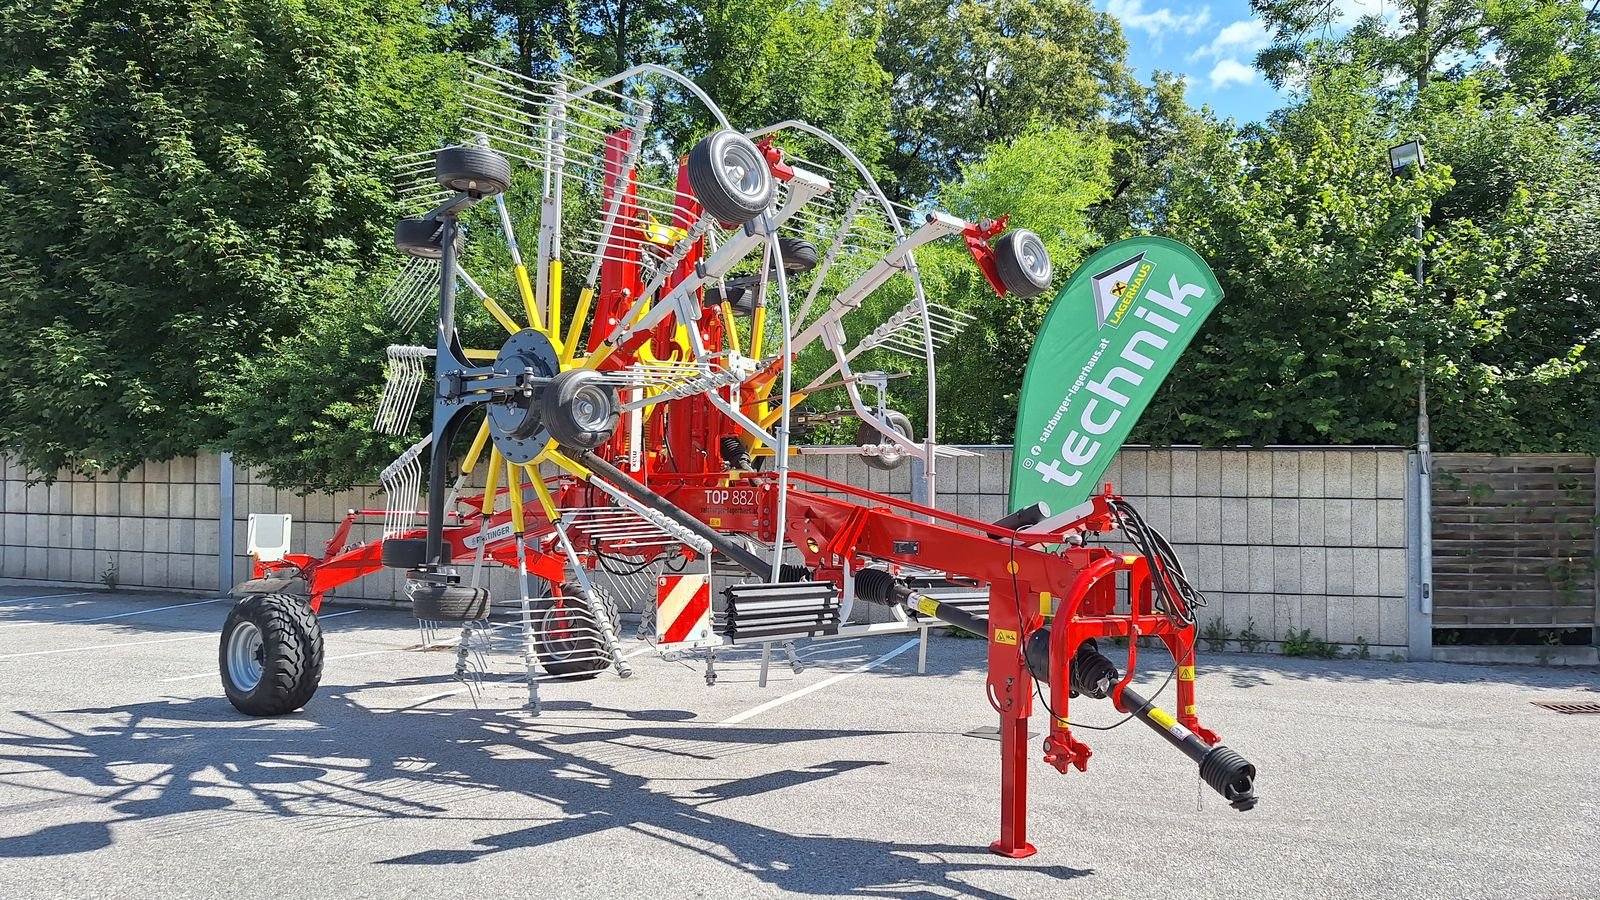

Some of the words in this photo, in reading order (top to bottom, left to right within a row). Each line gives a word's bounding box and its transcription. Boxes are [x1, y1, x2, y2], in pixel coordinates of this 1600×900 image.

[1110, 263, 1152, 325] LAGERHAUS
[1034, 273, 1206, 488] technik
[1039, 337, 1110, 443] salzburger-lagerhaus.at
[704, 489, 729, 505] TOP
[476, 525, 511, 545] PTINGER
